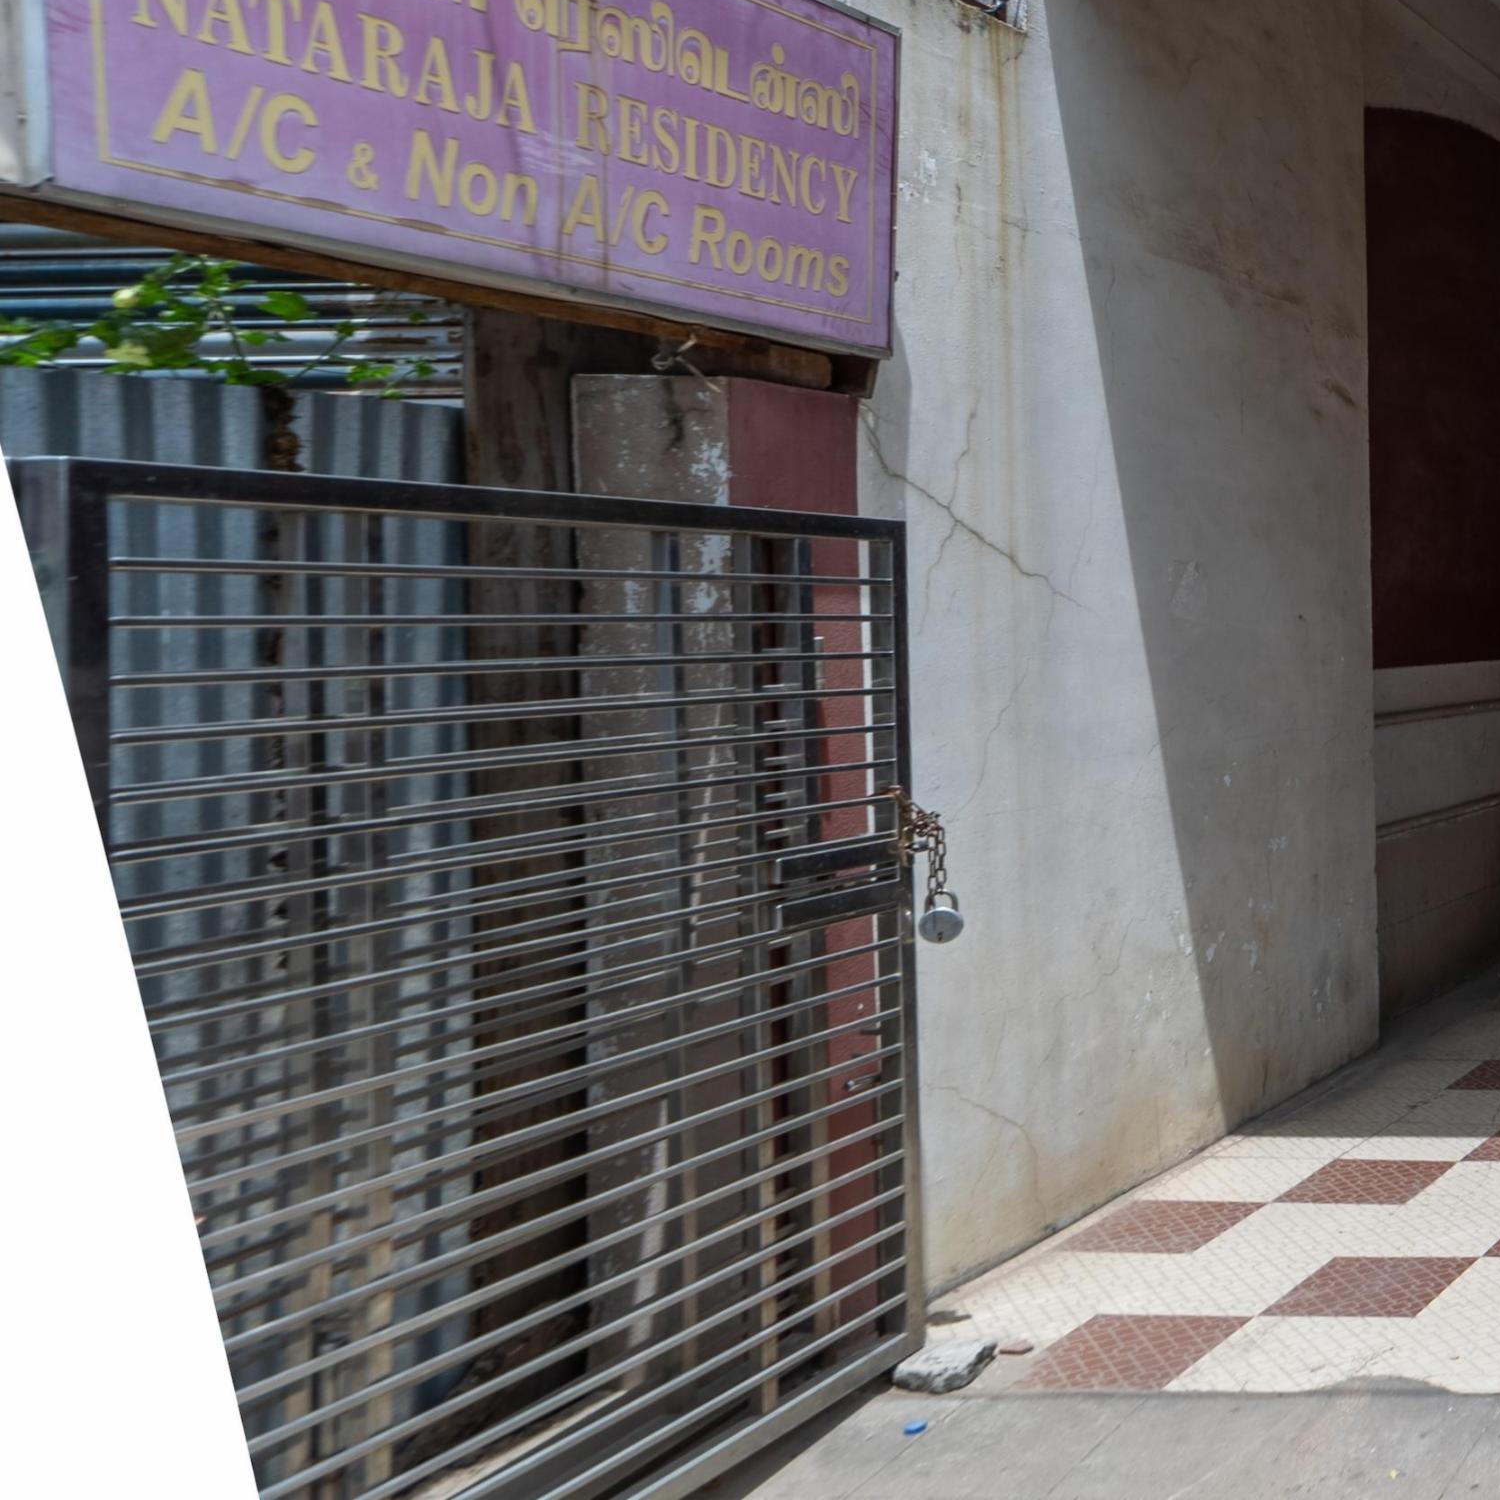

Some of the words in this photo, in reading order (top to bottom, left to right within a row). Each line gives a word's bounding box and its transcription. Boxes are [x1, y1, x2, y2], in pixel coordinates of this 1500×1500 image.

[151, 68, 319, 175] A/C
[347, 141, 379, 190] &
[406, 128, 539, 227] Non
[561, 172, 671, 256] A/C
[688, 203, 851, 298] Rooms
[575, 81, 859, 224] RESIDENCY
